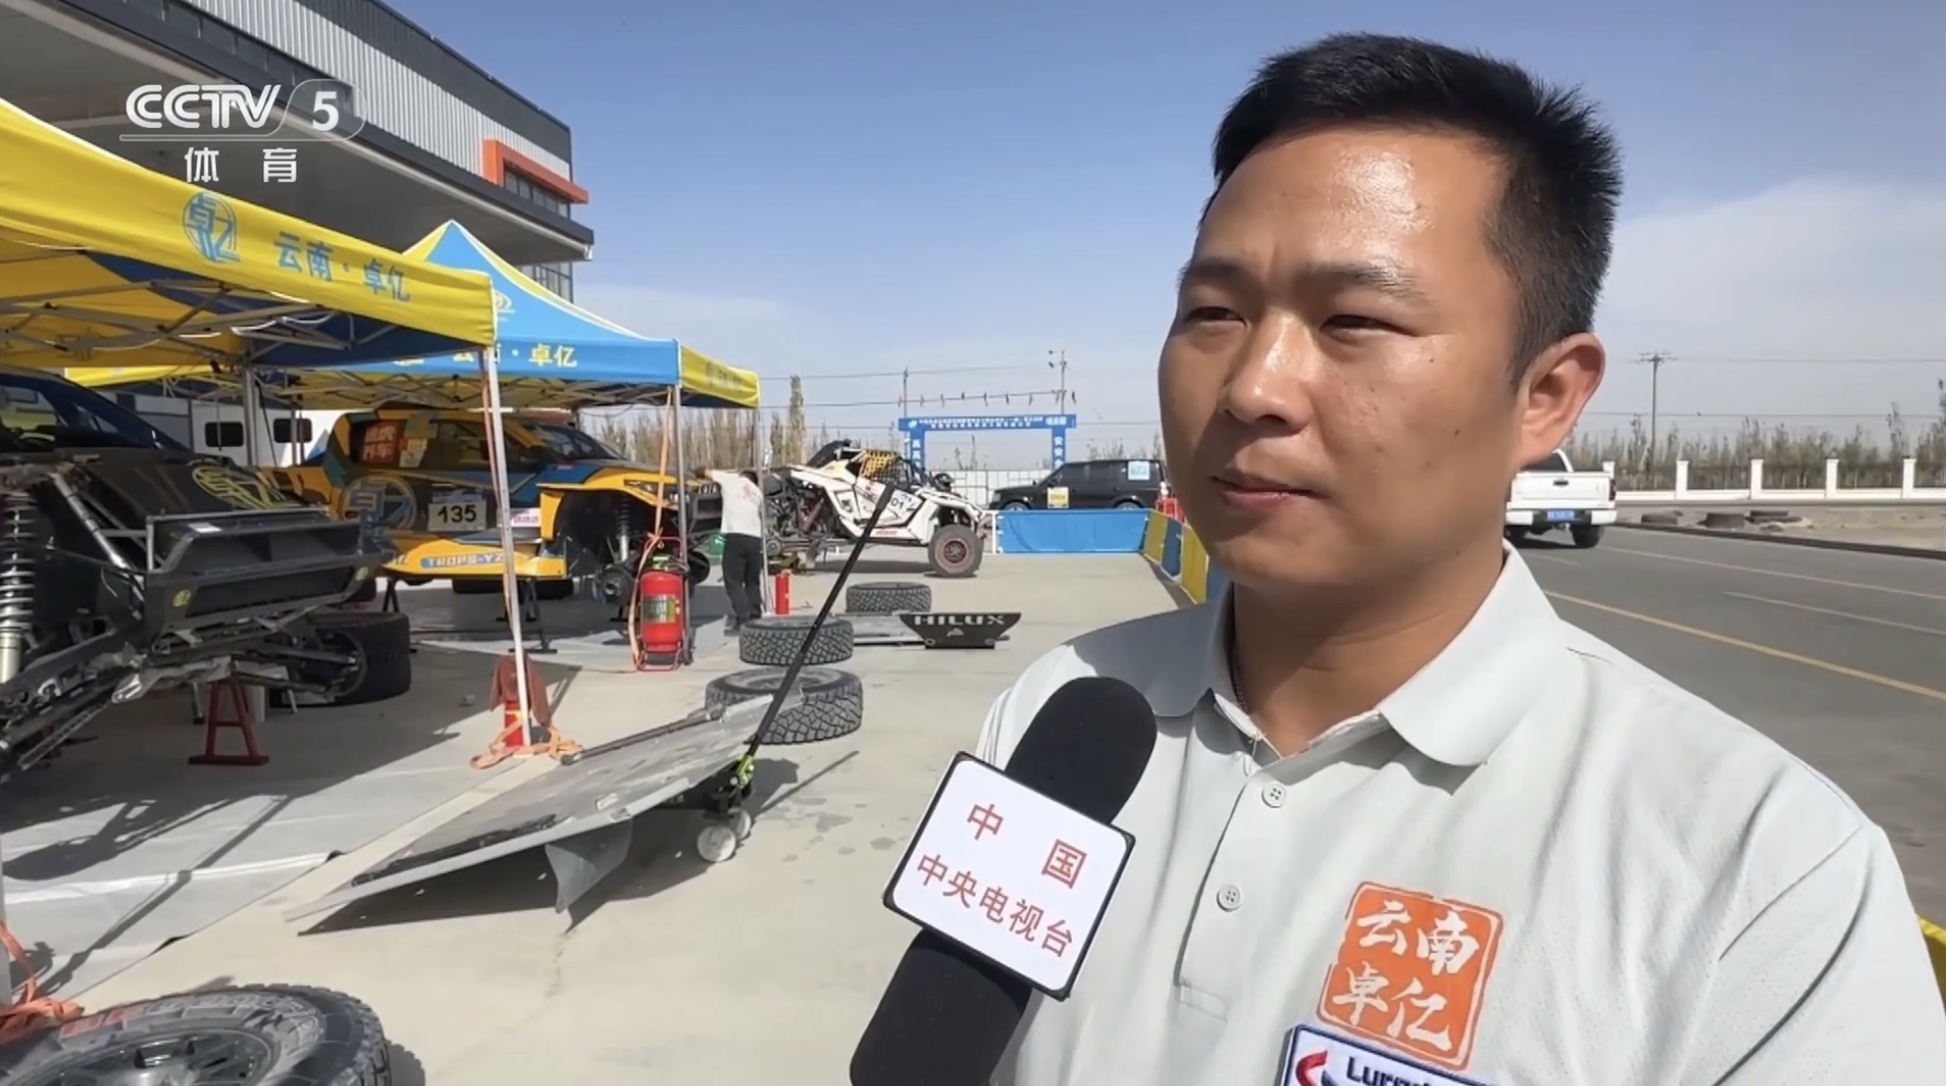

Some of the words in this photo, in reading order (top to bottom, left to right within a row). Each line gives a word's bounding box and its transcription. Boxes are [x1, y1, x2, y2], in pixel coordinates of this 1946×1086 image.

[437, 504, 477, 524] 135
[914, 615, 1005, 625] HILUX
[966, 803, 1088, 890] 中国
[916, 854, 1073, 958] 中央电视台
[1356, 899, 1480, 976] 云南
[1332, 960, 1453, 1052] 卓亿
